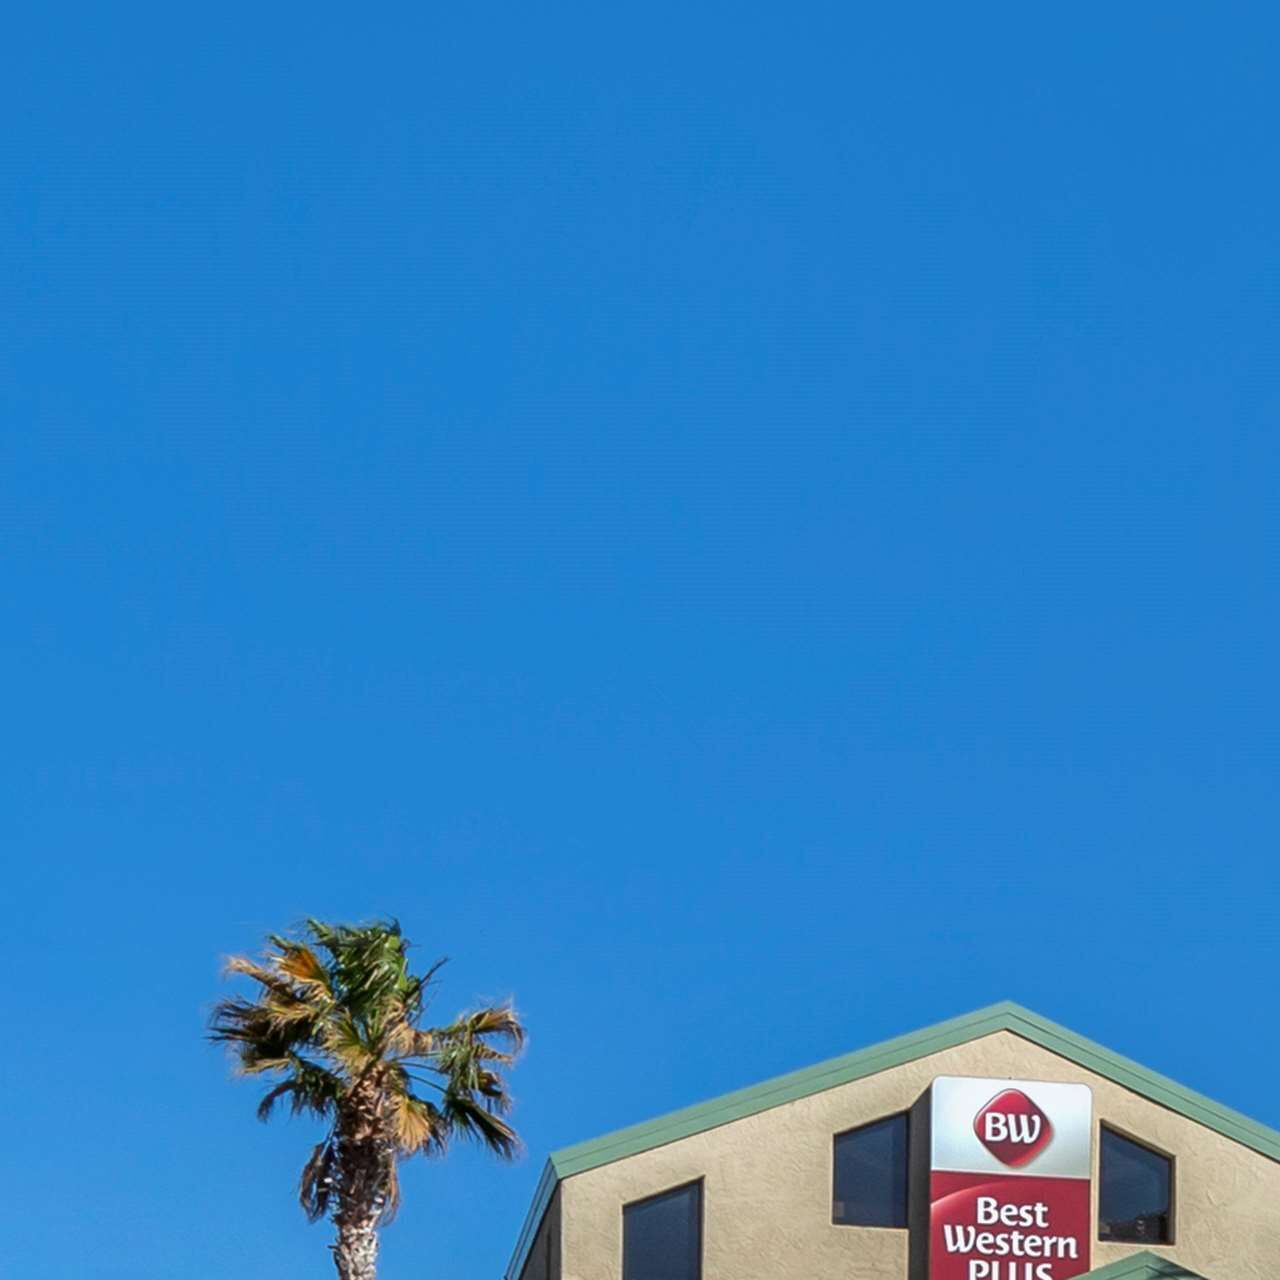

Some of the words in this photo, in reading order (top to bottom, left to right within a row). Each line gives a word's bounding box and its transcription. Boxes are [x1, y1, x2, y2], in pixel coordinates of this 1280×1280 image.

[984, 1111, 1041, 1144] BW
[976, 1196, 1049, 1227] Best
[943, 1224, 1079, 1259] Western
